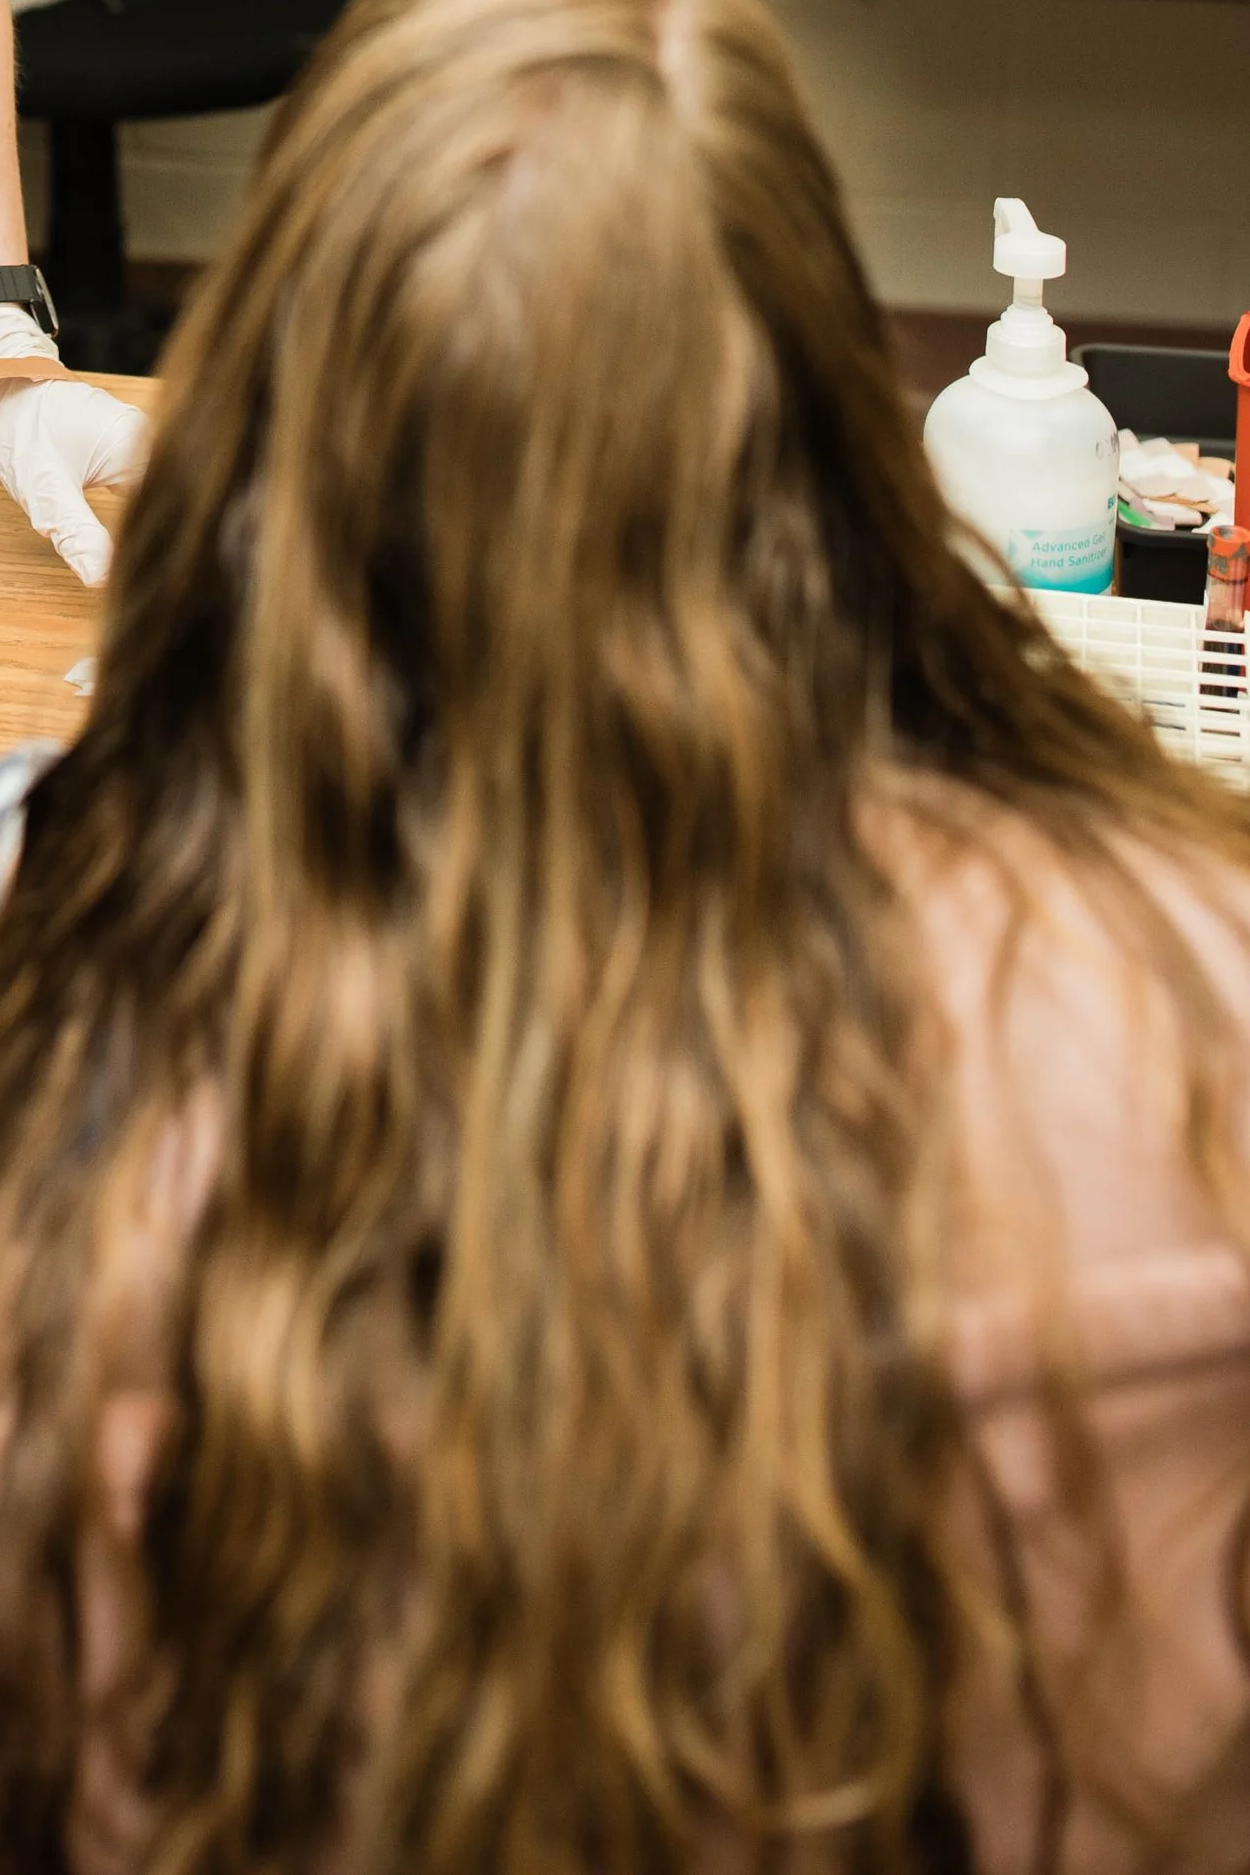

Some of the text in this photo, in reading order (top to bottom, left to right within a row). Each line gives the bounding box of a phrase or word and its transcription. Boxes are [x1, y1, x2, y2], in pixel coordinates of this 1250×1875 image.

[1032, 531, 1106, 553] Advanced Gel
[1031, 547, 1108, 568] Hand Sanitizer
